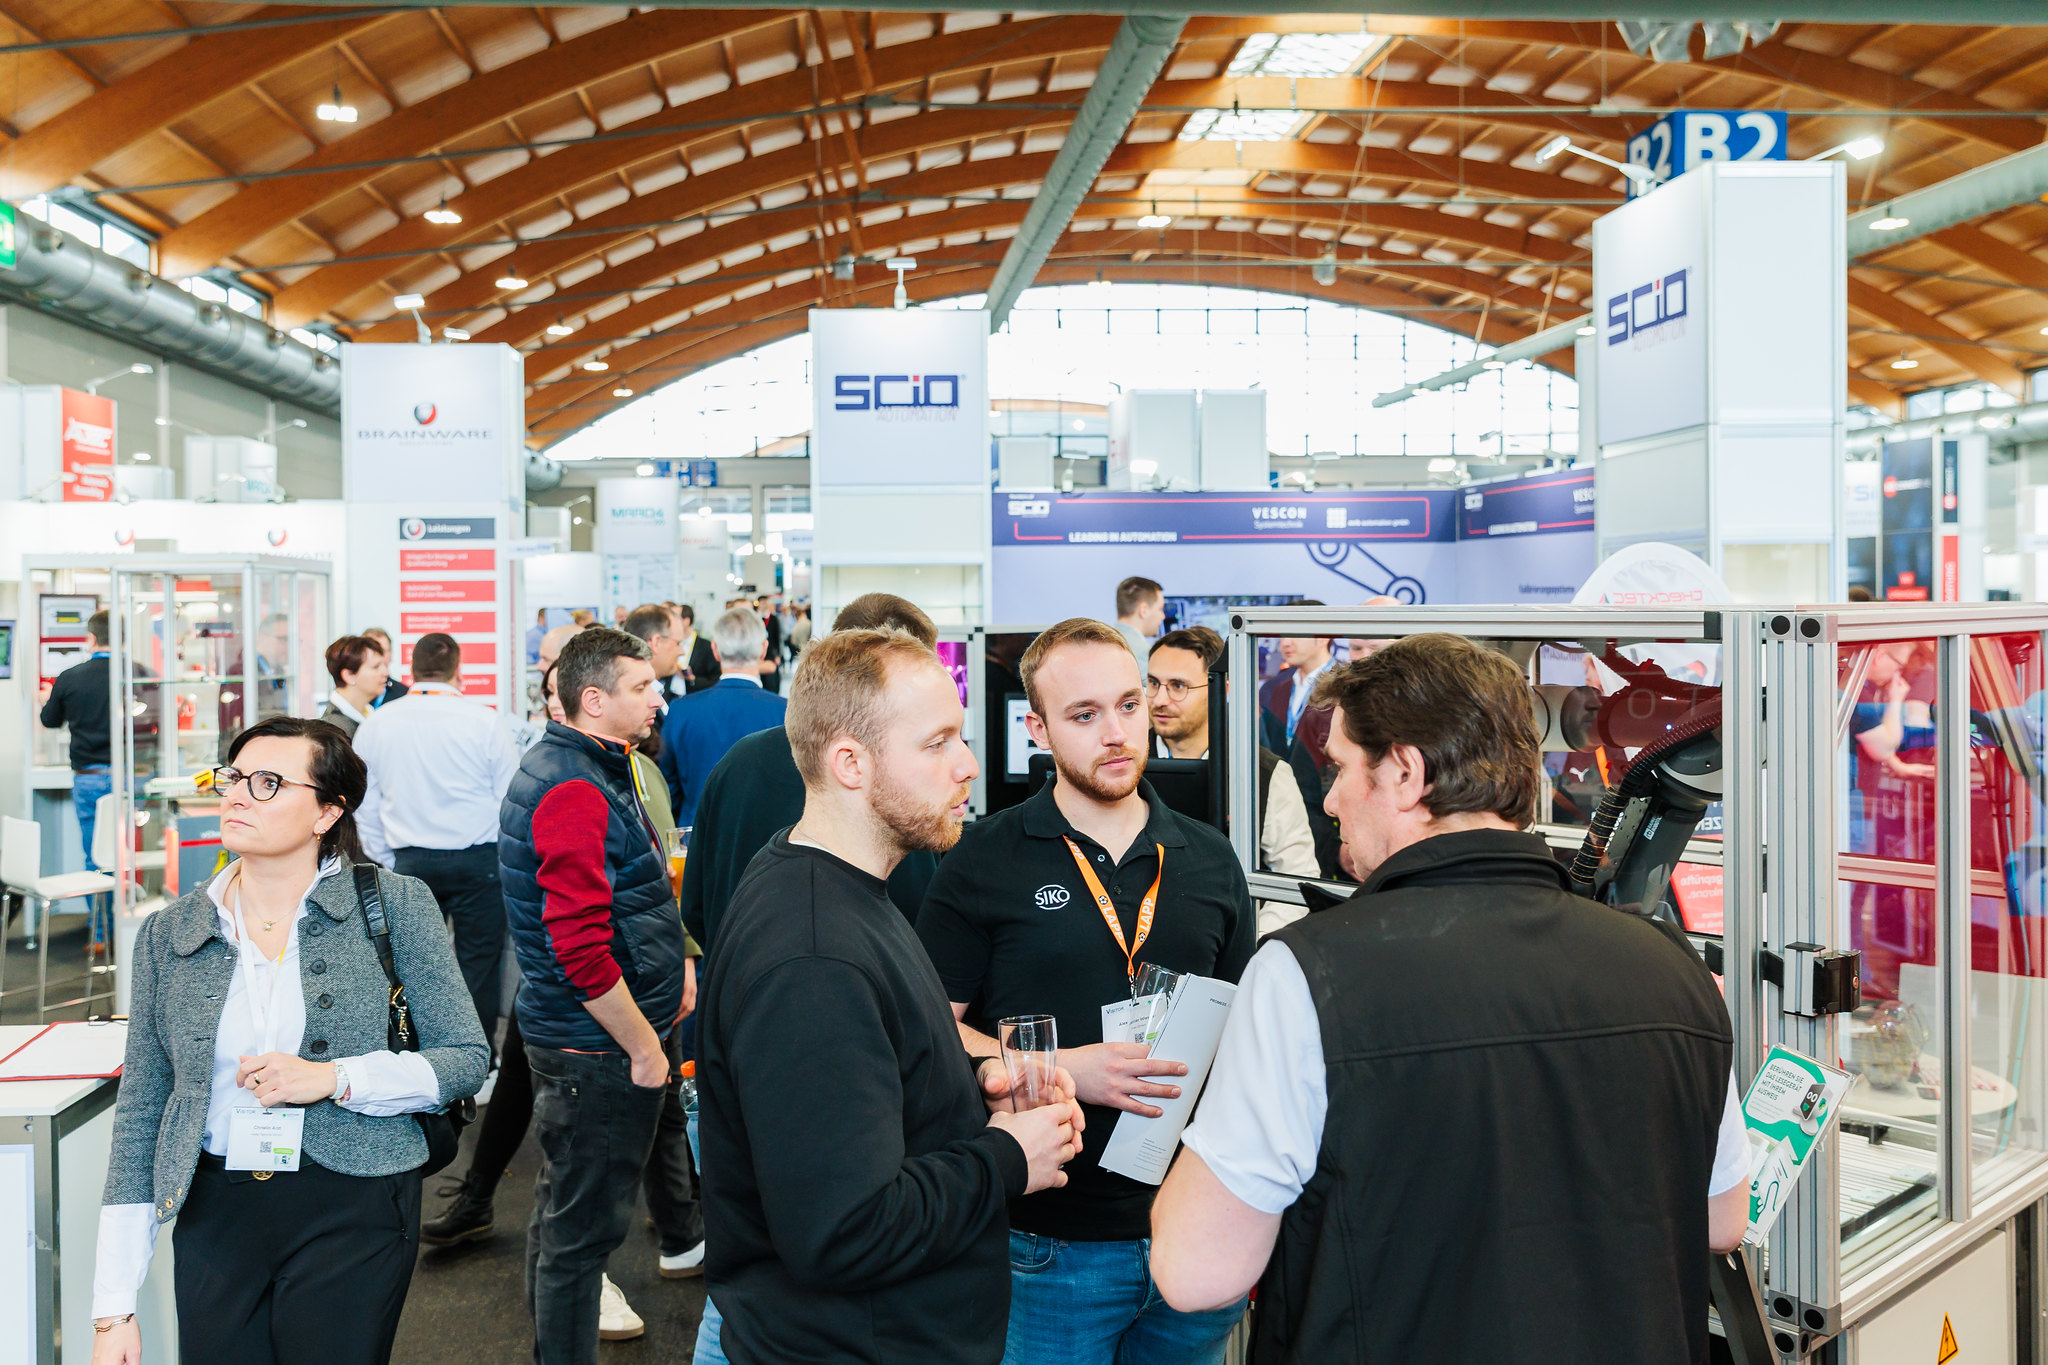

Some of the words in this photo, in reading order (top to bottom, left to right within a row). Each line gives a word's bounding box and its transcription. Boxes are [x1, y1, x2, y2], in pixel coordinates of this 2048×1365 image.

[1684, 113, 1778, 172] B2
[877, 405, 957, 422] AUTOMATION
[357, 429, 493, 440] BRAINWARE
[1252, 507, 1307, 520] VESCON
[1068, 532, 1107, 543] LEADING
[1120, 531, 1178, 542] AUTOMATION
[1035, 890, 1070, 907] SIKO
[1139, 897, 1155, 932] LAPP
[1103, 906, 1124, 941] LAPP
[1765, 1072, 1777, 1082] DAS
[1761, 1080, 1771, 1089] MIT
[1757, 1088, 1778, 1101] AUSWEIS
